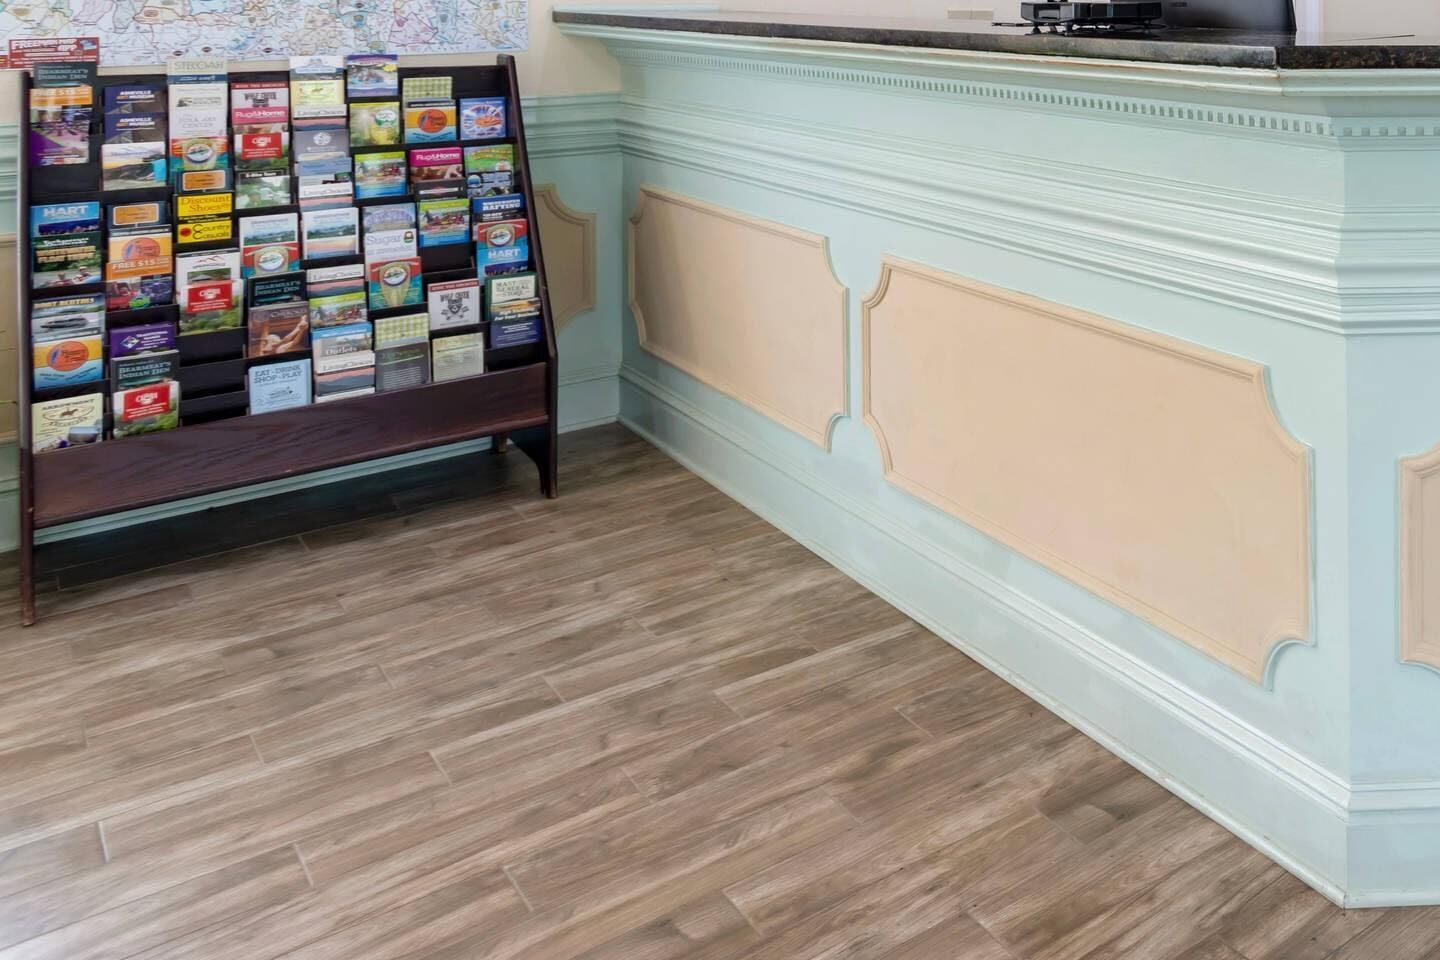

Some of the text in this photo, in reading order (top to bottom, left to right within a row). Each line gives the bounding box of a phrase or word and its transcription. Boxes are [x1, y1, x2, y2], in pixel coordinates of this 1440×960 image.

[181, 195, 230, 206] Discount
[43, 205, 89, 217] HART
[482, 203, 521, 211] RAFTING
[193, 223, 230, 233] Country
[366, 234, 402, 246] Sugar
[488, 248, 521, 259] HART
[112, 262, 136, 270] FREE
[119, 361, 172, 374] BEARMEAT'S
[119, 367, 171, 379] INDIAN DEN
